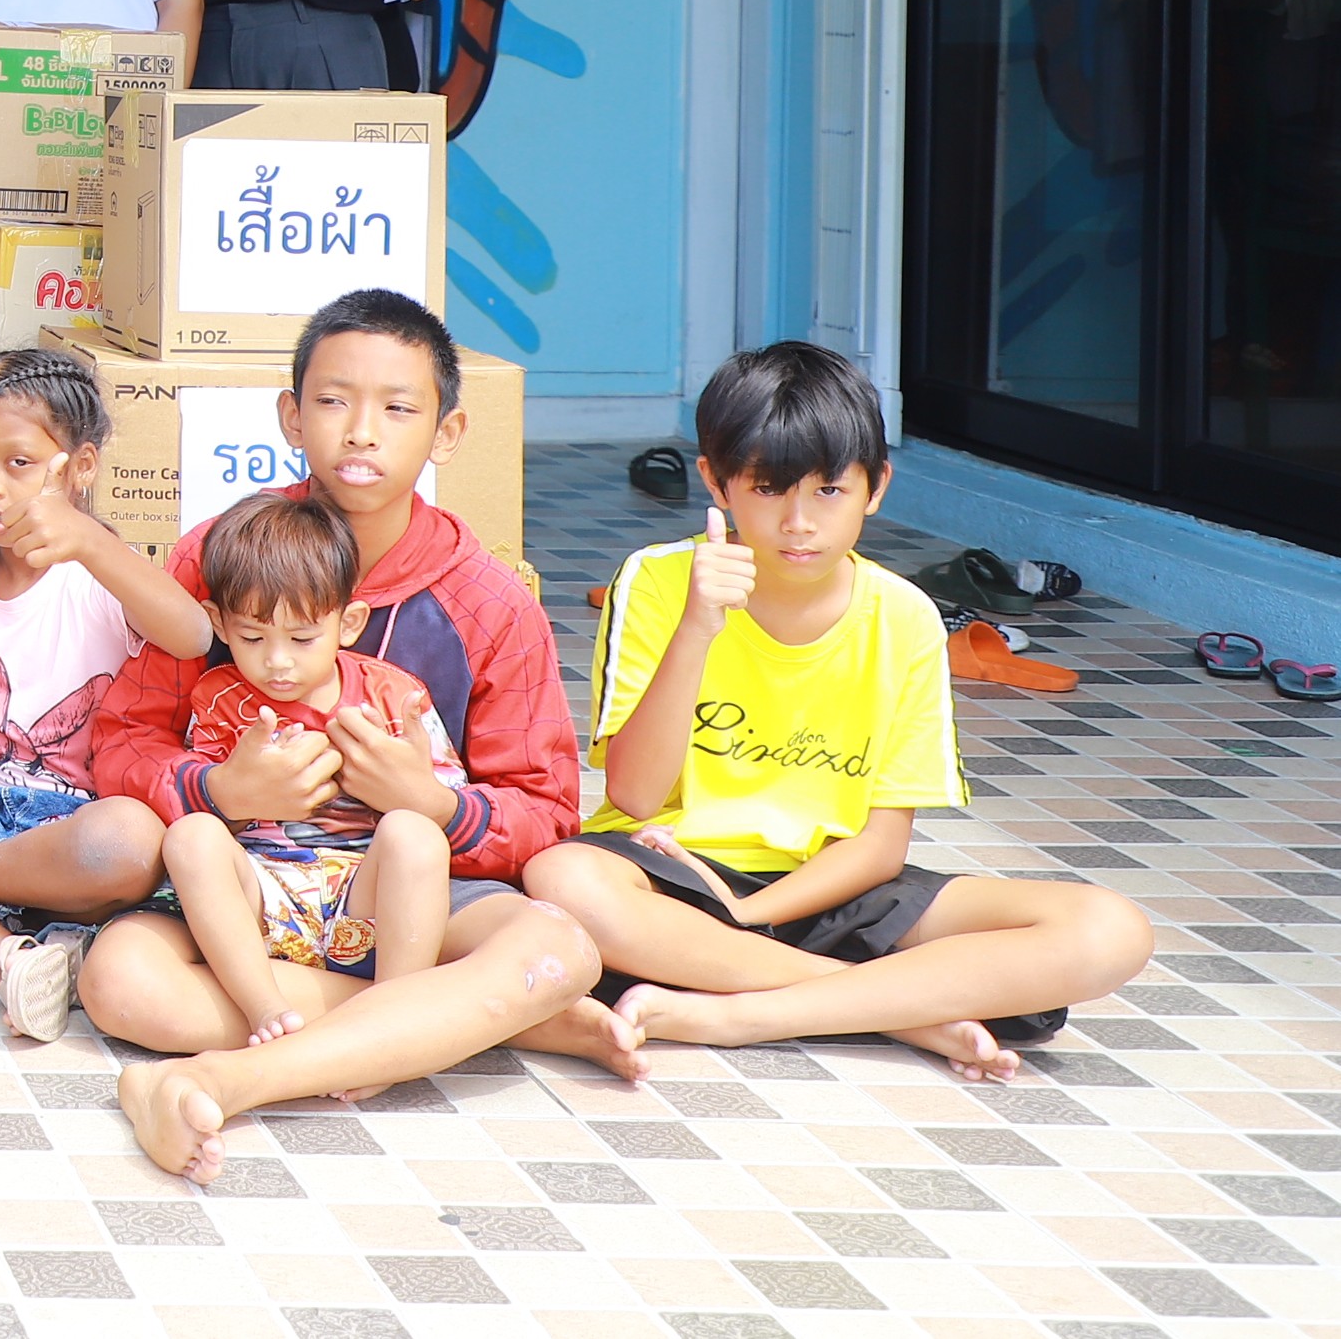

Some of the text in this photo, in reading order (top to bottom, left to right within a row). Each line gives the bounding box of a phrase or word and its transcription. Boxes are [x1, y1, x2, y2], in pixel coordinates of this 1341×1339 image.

[22, 56, 45, 72] 48
[217, 165, 392, 256] เสื้อผ้า
[176, 330, 232, 344] 1 DOZ.
[214, 444, 308, 484] รอง
[111, 466, 180, 480] Toner Ca
[111, 486, 181, 500] Cartouch
[110, 511, 141, 521] Outer
[143, 511, 162, 522] box
